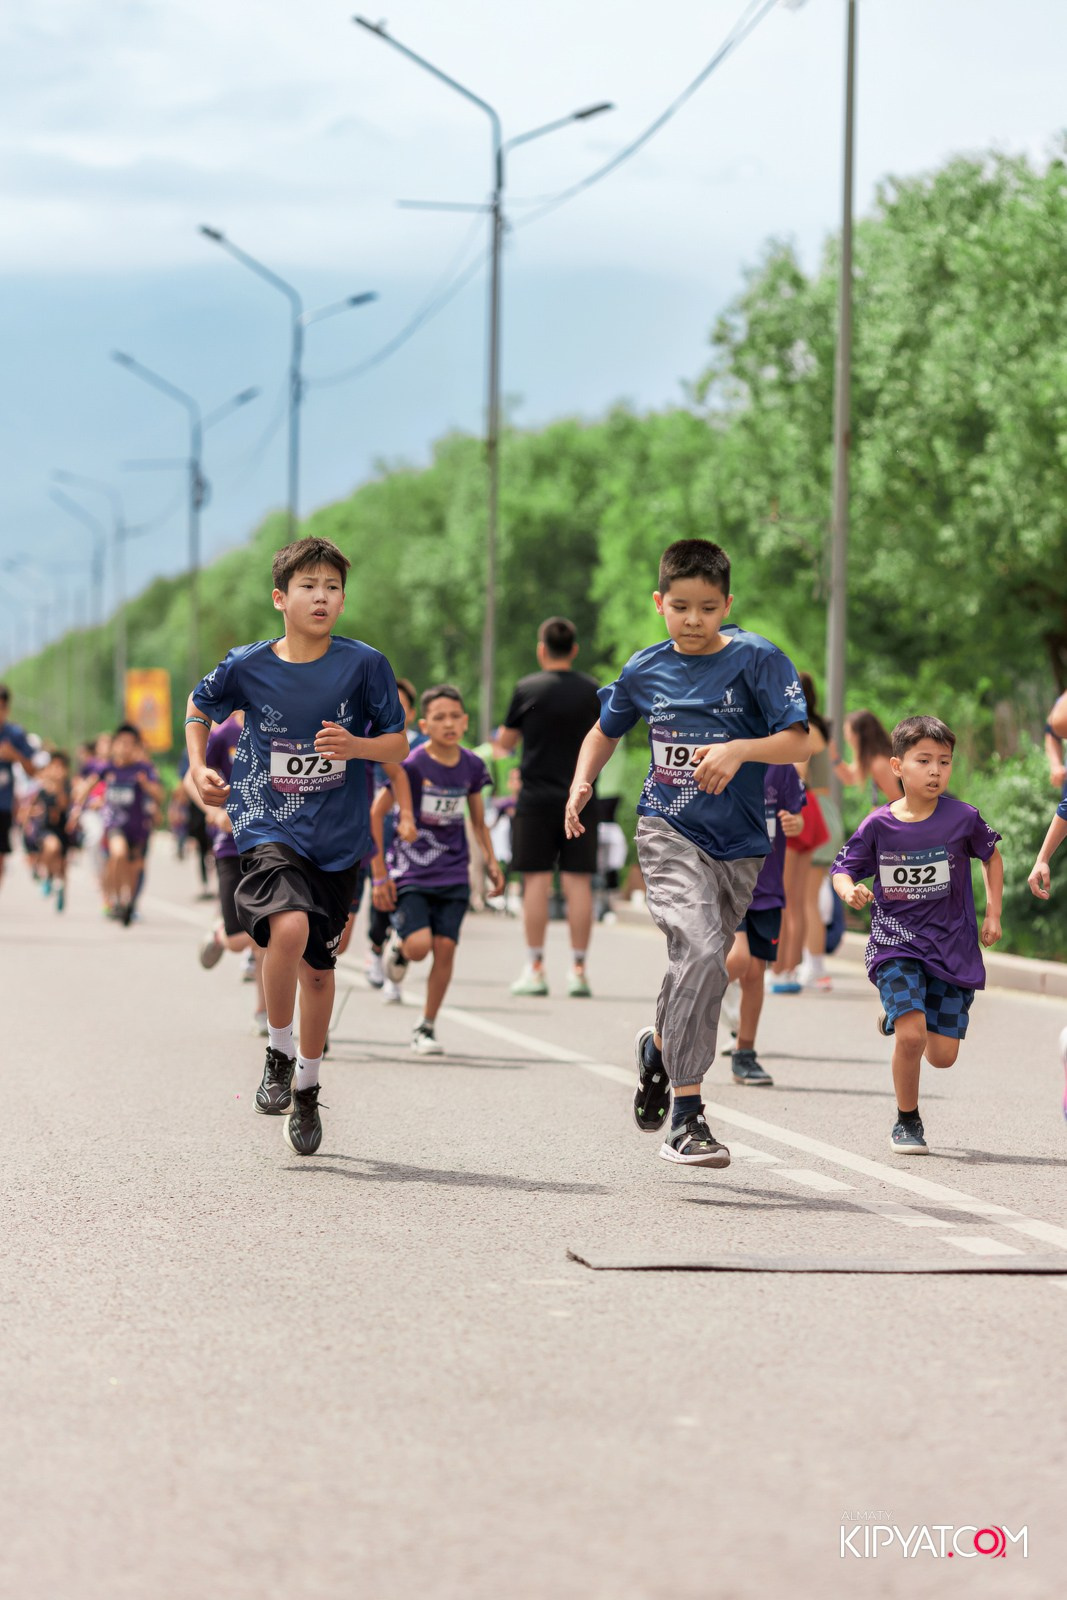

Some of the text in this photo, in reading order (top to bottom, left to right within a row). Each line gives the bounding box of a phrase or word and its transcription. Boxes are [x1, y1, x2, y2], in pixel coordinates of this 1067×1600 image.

[286, 756, 333, 775] 073
[273, 773, 344, 785] БАЛАЛАР ЖАРЫСЫ
[435, 799, 458, 812] 13
[893, 865, 937, 885] 032
[916, 882, 949, 893] ЖАРЫСЫ
